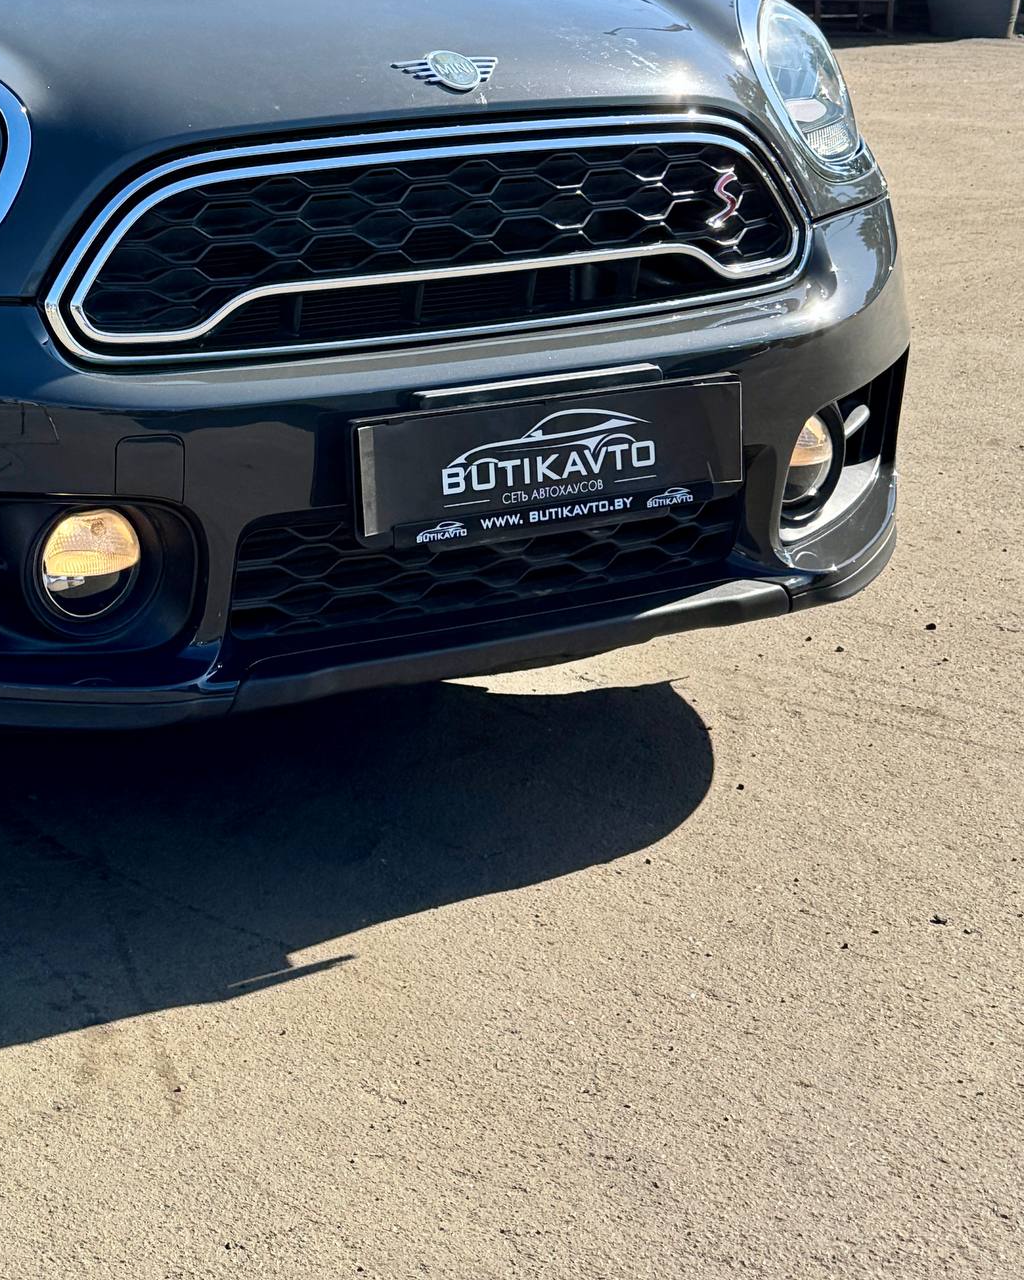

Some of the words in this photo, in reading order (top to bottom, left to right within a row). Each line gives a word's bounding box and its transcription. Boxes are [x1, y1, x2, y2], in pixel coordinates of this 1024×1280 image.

[441, 439, 656, 496] BUTIKAVTO
[502, 490, 529, 505] СЕТЬ
[531, 479, 604, 501] АВТОХАУСОВ
[646, 494, 694, 509] BUTIKAVTO
[480, 513, 524, 530] WWW.
[529, 496, 634, 523] BUTIKAVTO.BY
[416, 528, 467, 544] BUTIKAVTO
